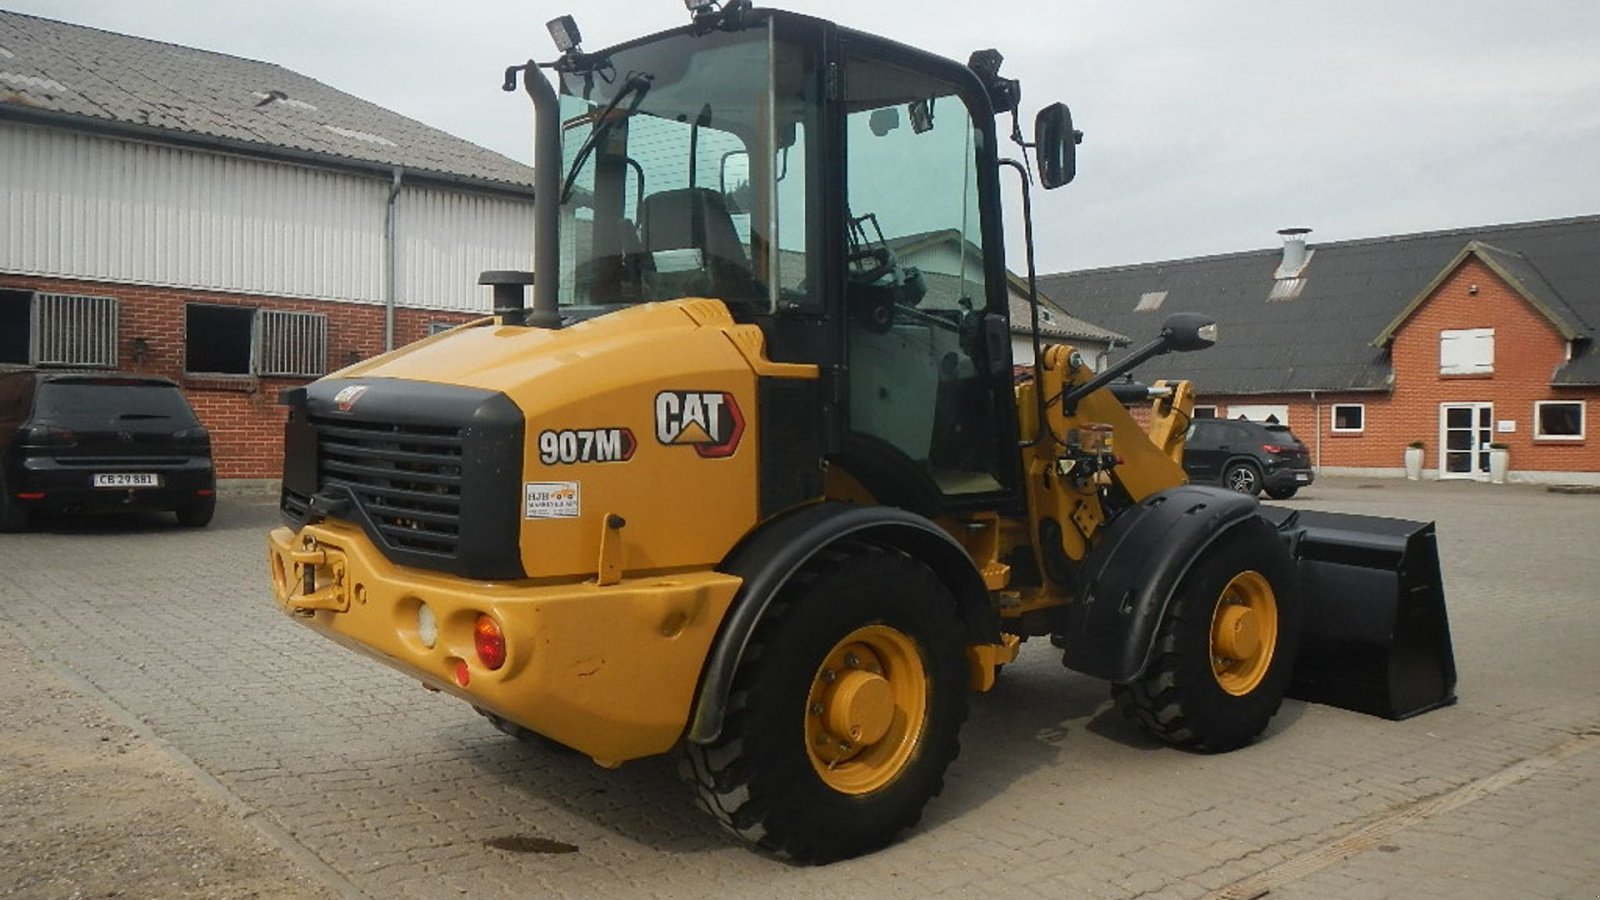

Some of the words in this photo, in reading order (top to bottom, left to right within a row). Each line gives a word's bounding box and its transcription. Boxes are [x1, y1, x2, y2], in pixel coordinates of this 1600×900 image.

[656, 392, 724, 443] CAT
[540, 429, 622, 464] 907M
[100, 474, 115, 484] CB
[528, 492, 549, 501] HJH
